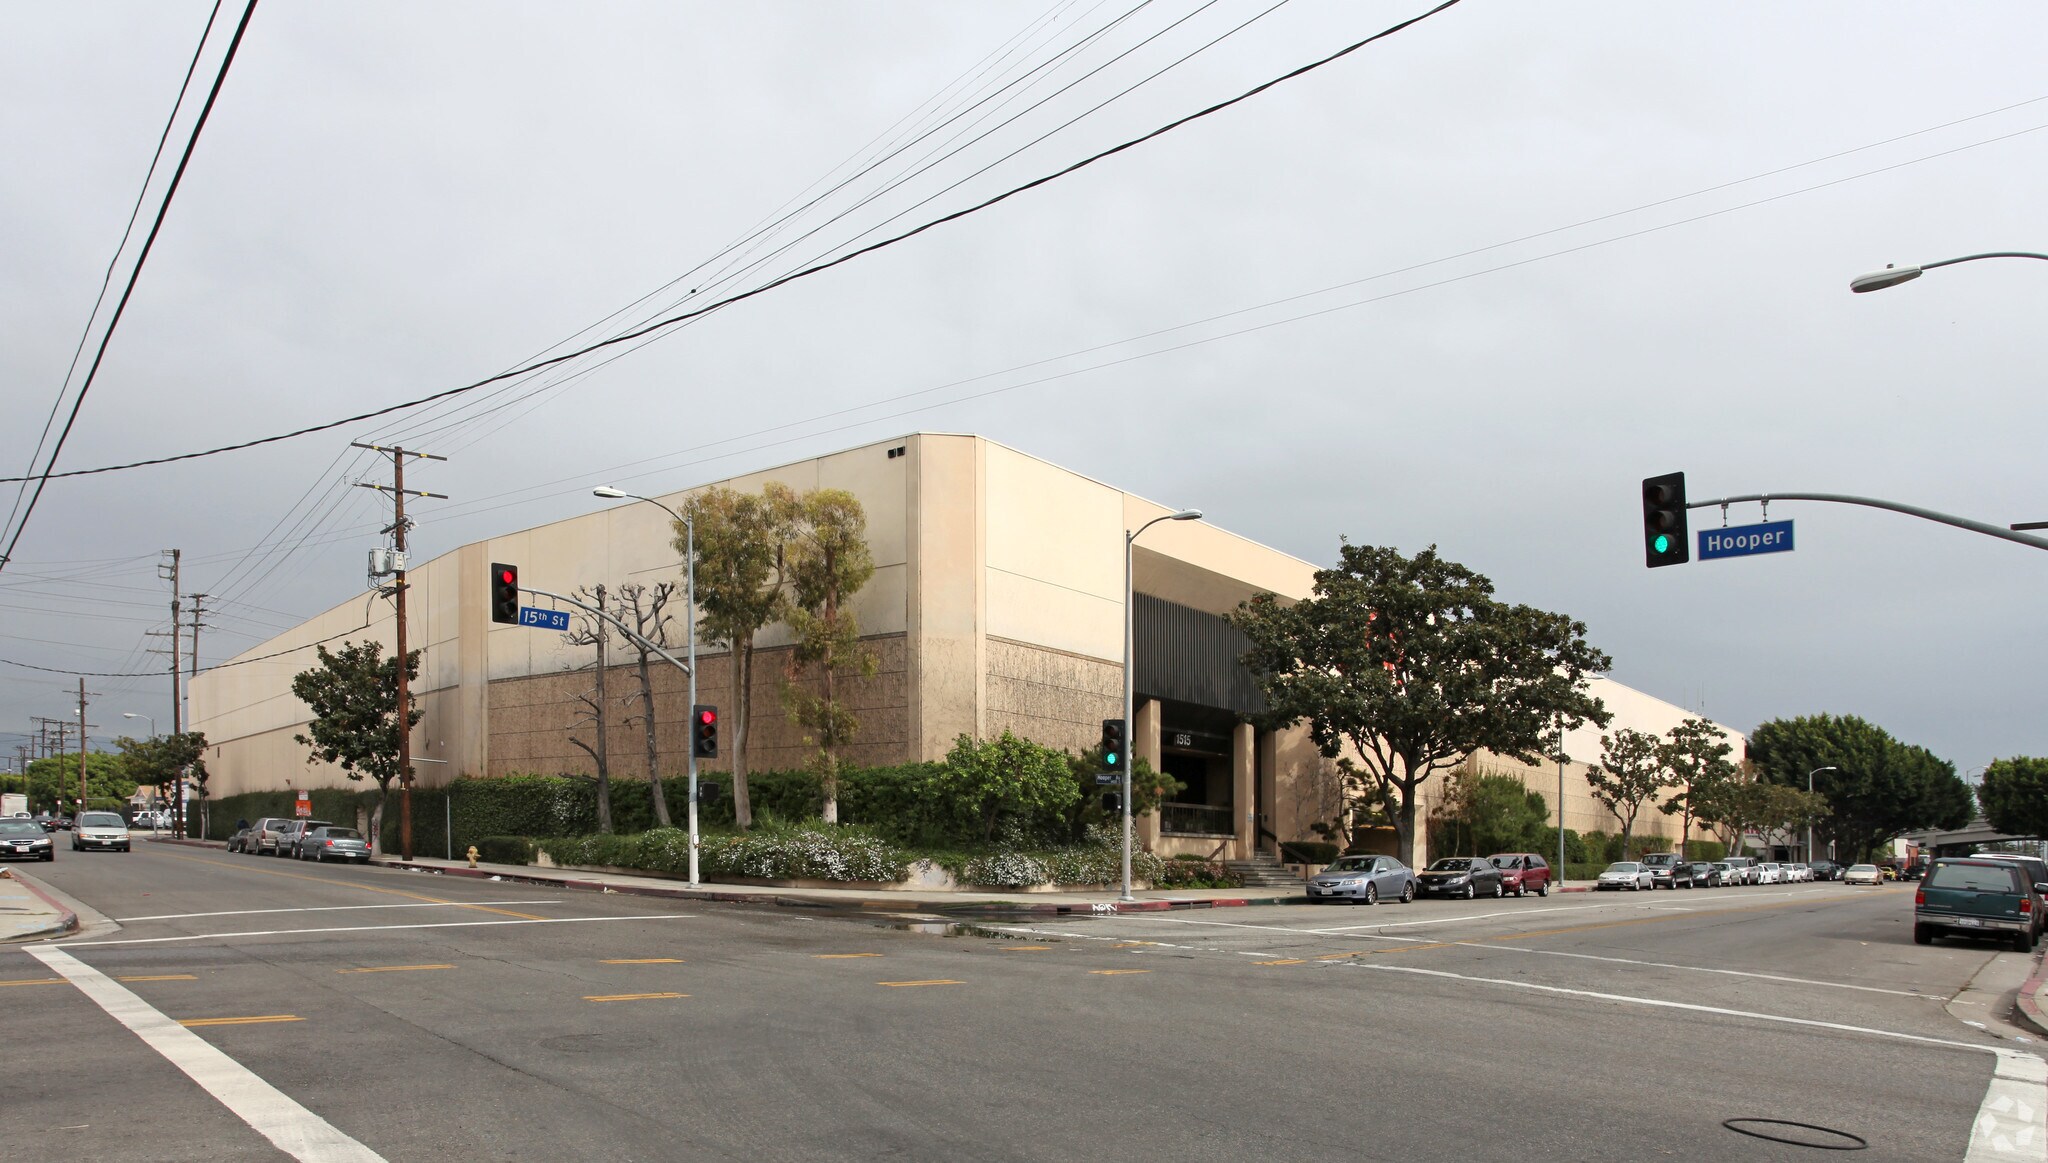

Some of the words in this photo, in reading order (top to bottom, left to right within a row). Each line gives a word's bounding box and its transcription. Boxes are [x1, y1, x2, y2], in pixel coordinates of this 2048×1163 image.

[1708, 531, 1784, 552] Hooper
[524, 611, 547, 623] 15th
[552, 615, 564, 626] St
[1176, 734, 1191, 746] 1515
